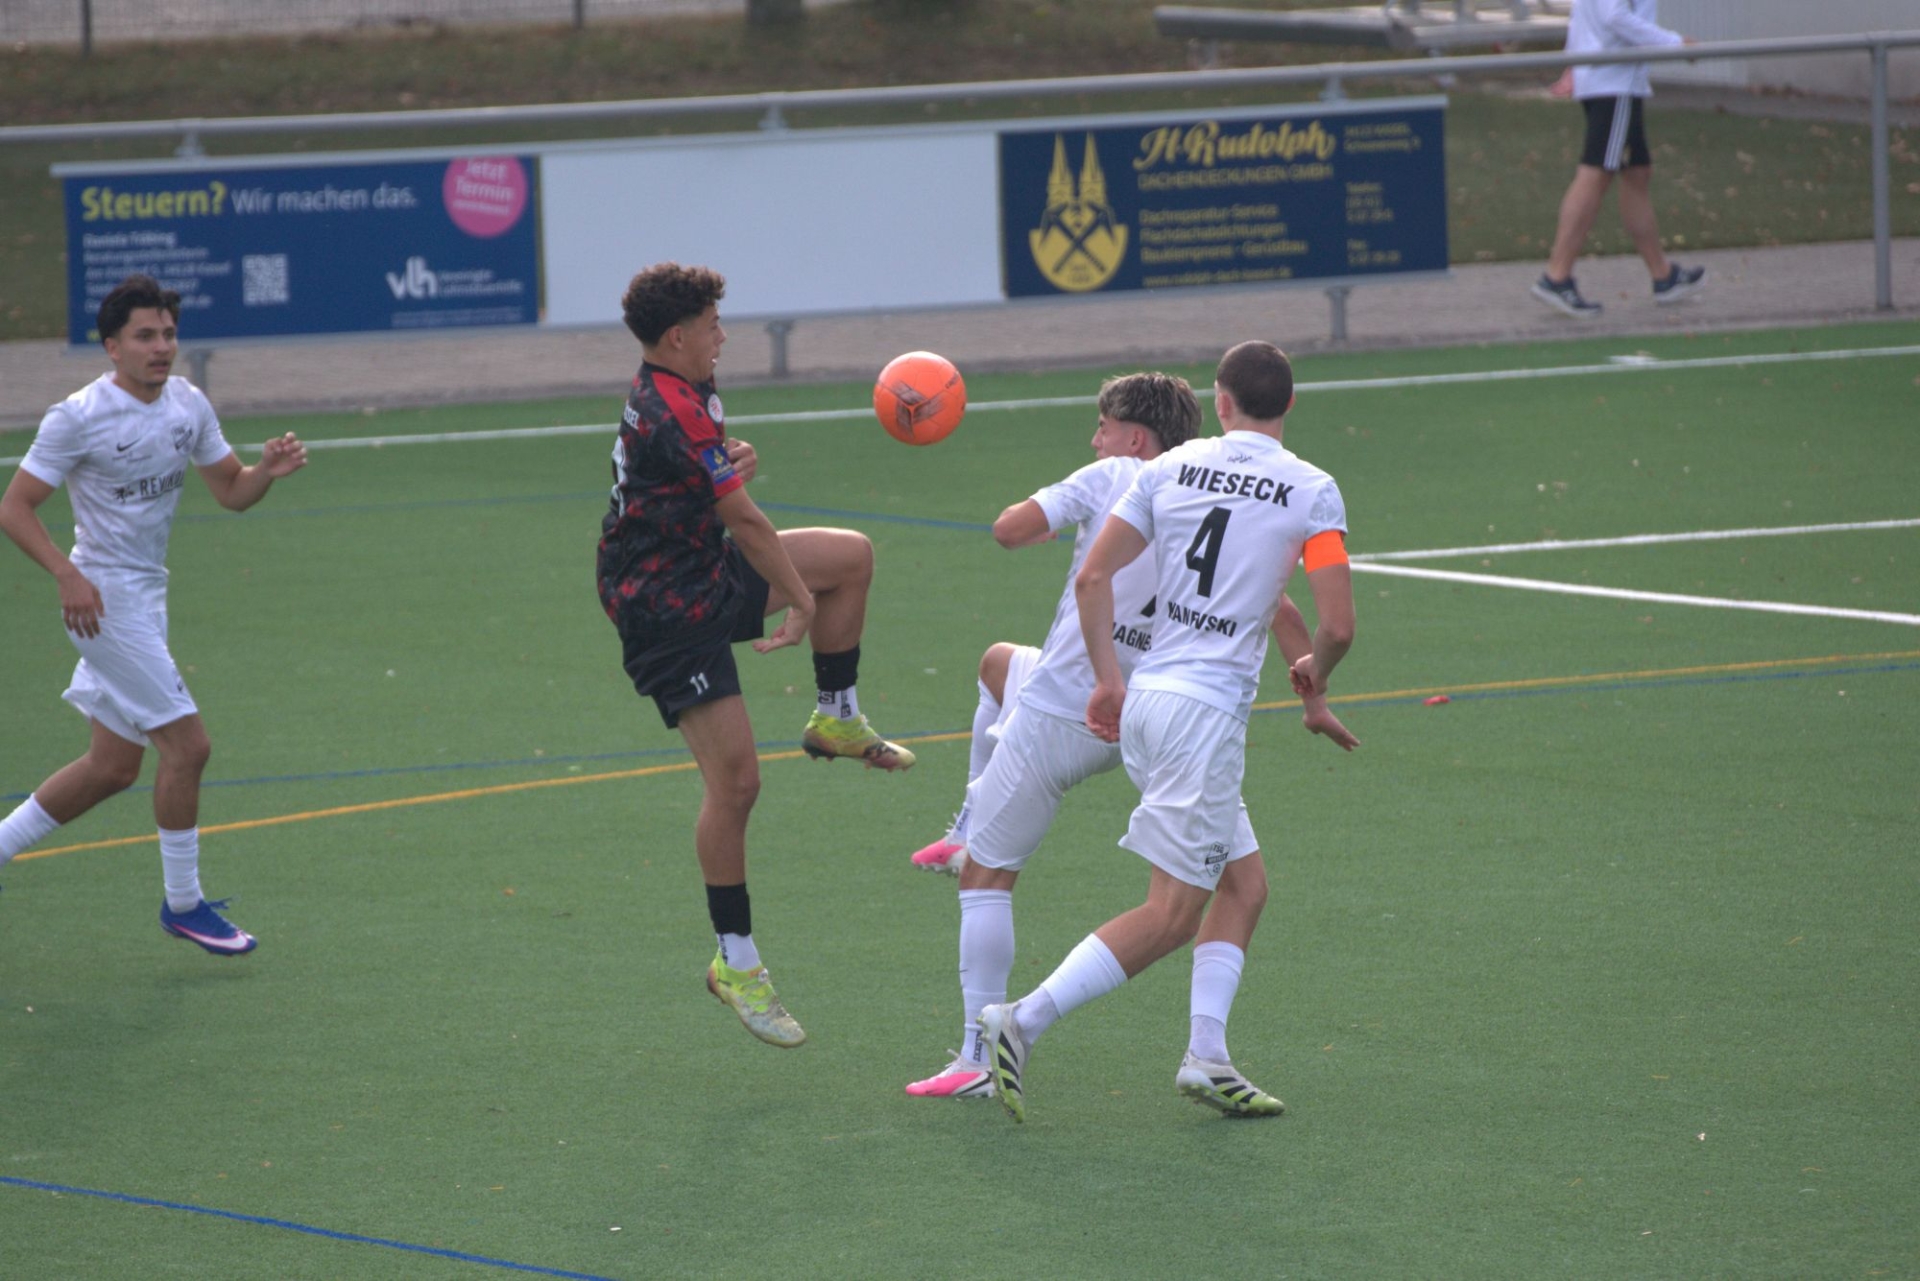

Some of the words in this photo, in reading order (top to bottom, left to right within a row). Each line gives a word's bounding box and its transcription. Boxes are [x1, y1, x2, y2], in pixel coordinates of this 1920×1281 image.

[81, 181, 226, 221] Steuern?
[231, 188, 274, 215] Wir
[277, 184, 365, 213] machen
[372, 182, 417, 208] das.
[456, 175, 513, 201] Termin
[385, 255, 438, 301] vlh
[1177, 463, 1295, 508] WIESECK
[1185, 506, 1232, 598] 4
[1112, 622, 1152, 652] AGNE
[690, 672, 709, 695] 11
